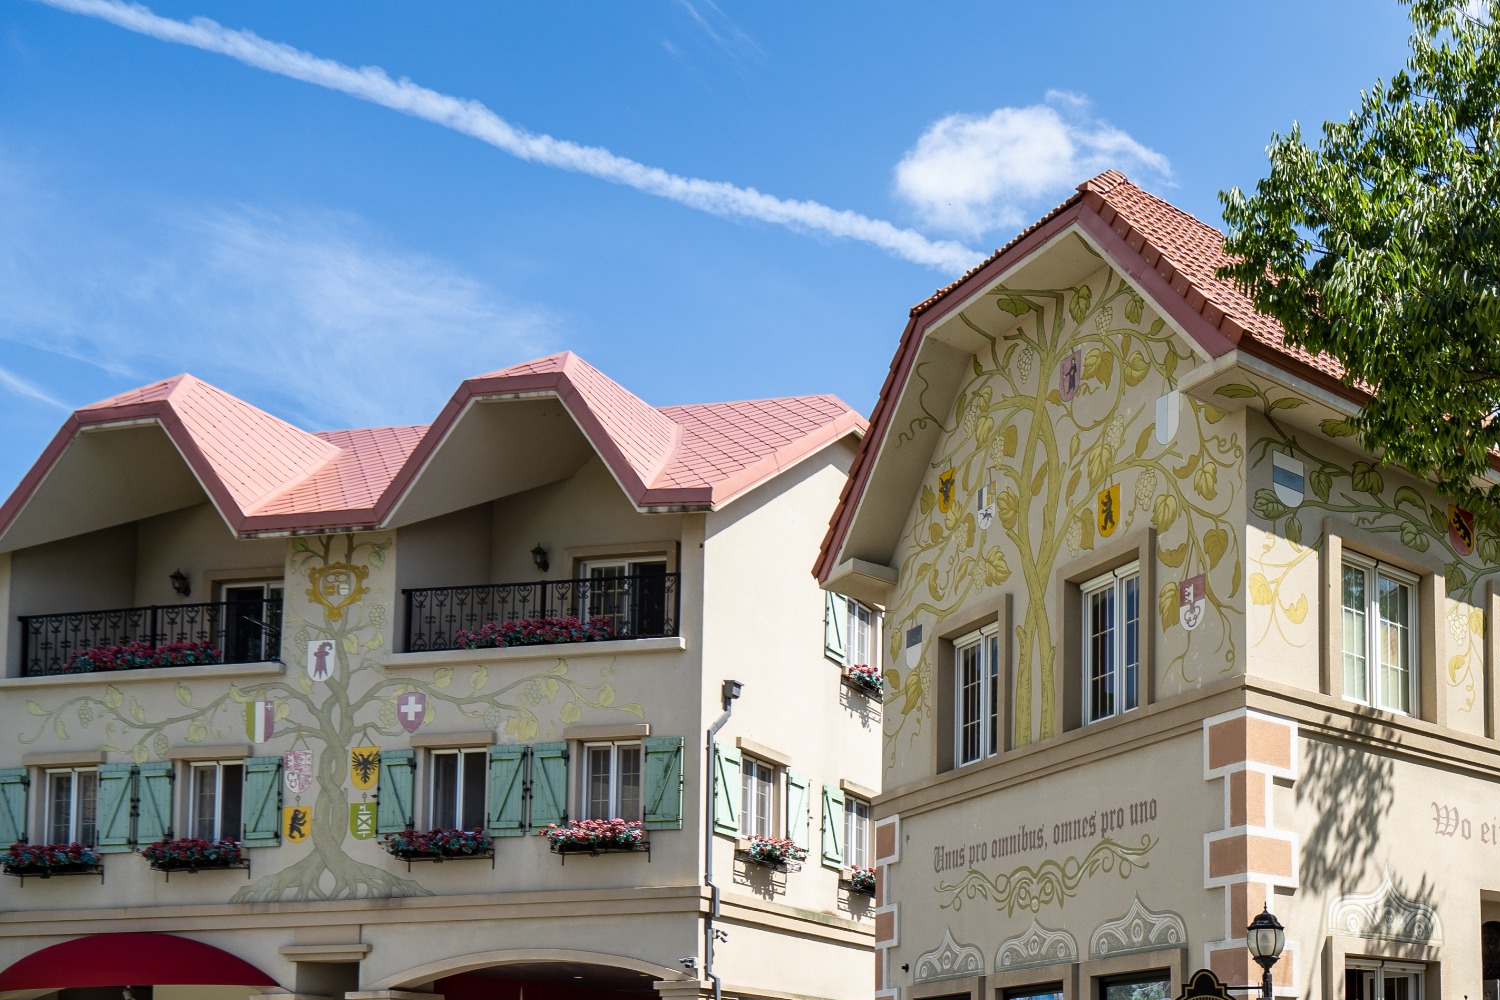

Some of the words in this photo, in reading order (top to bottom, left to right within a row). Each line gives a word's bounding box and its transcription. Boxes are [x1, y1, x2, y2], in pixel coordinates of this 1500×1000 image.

[933, 844, 965, 874] Unus
[969, 839, 988, 870] pro
[991, 823, 1048, 859] omnibus,
[1053, 810, 1097, 846] omnes
[1100, 806, 1125, 839] pro
[1129, 798, 1158, 827] uno
[1431, 801, 1472, 841] Wo
